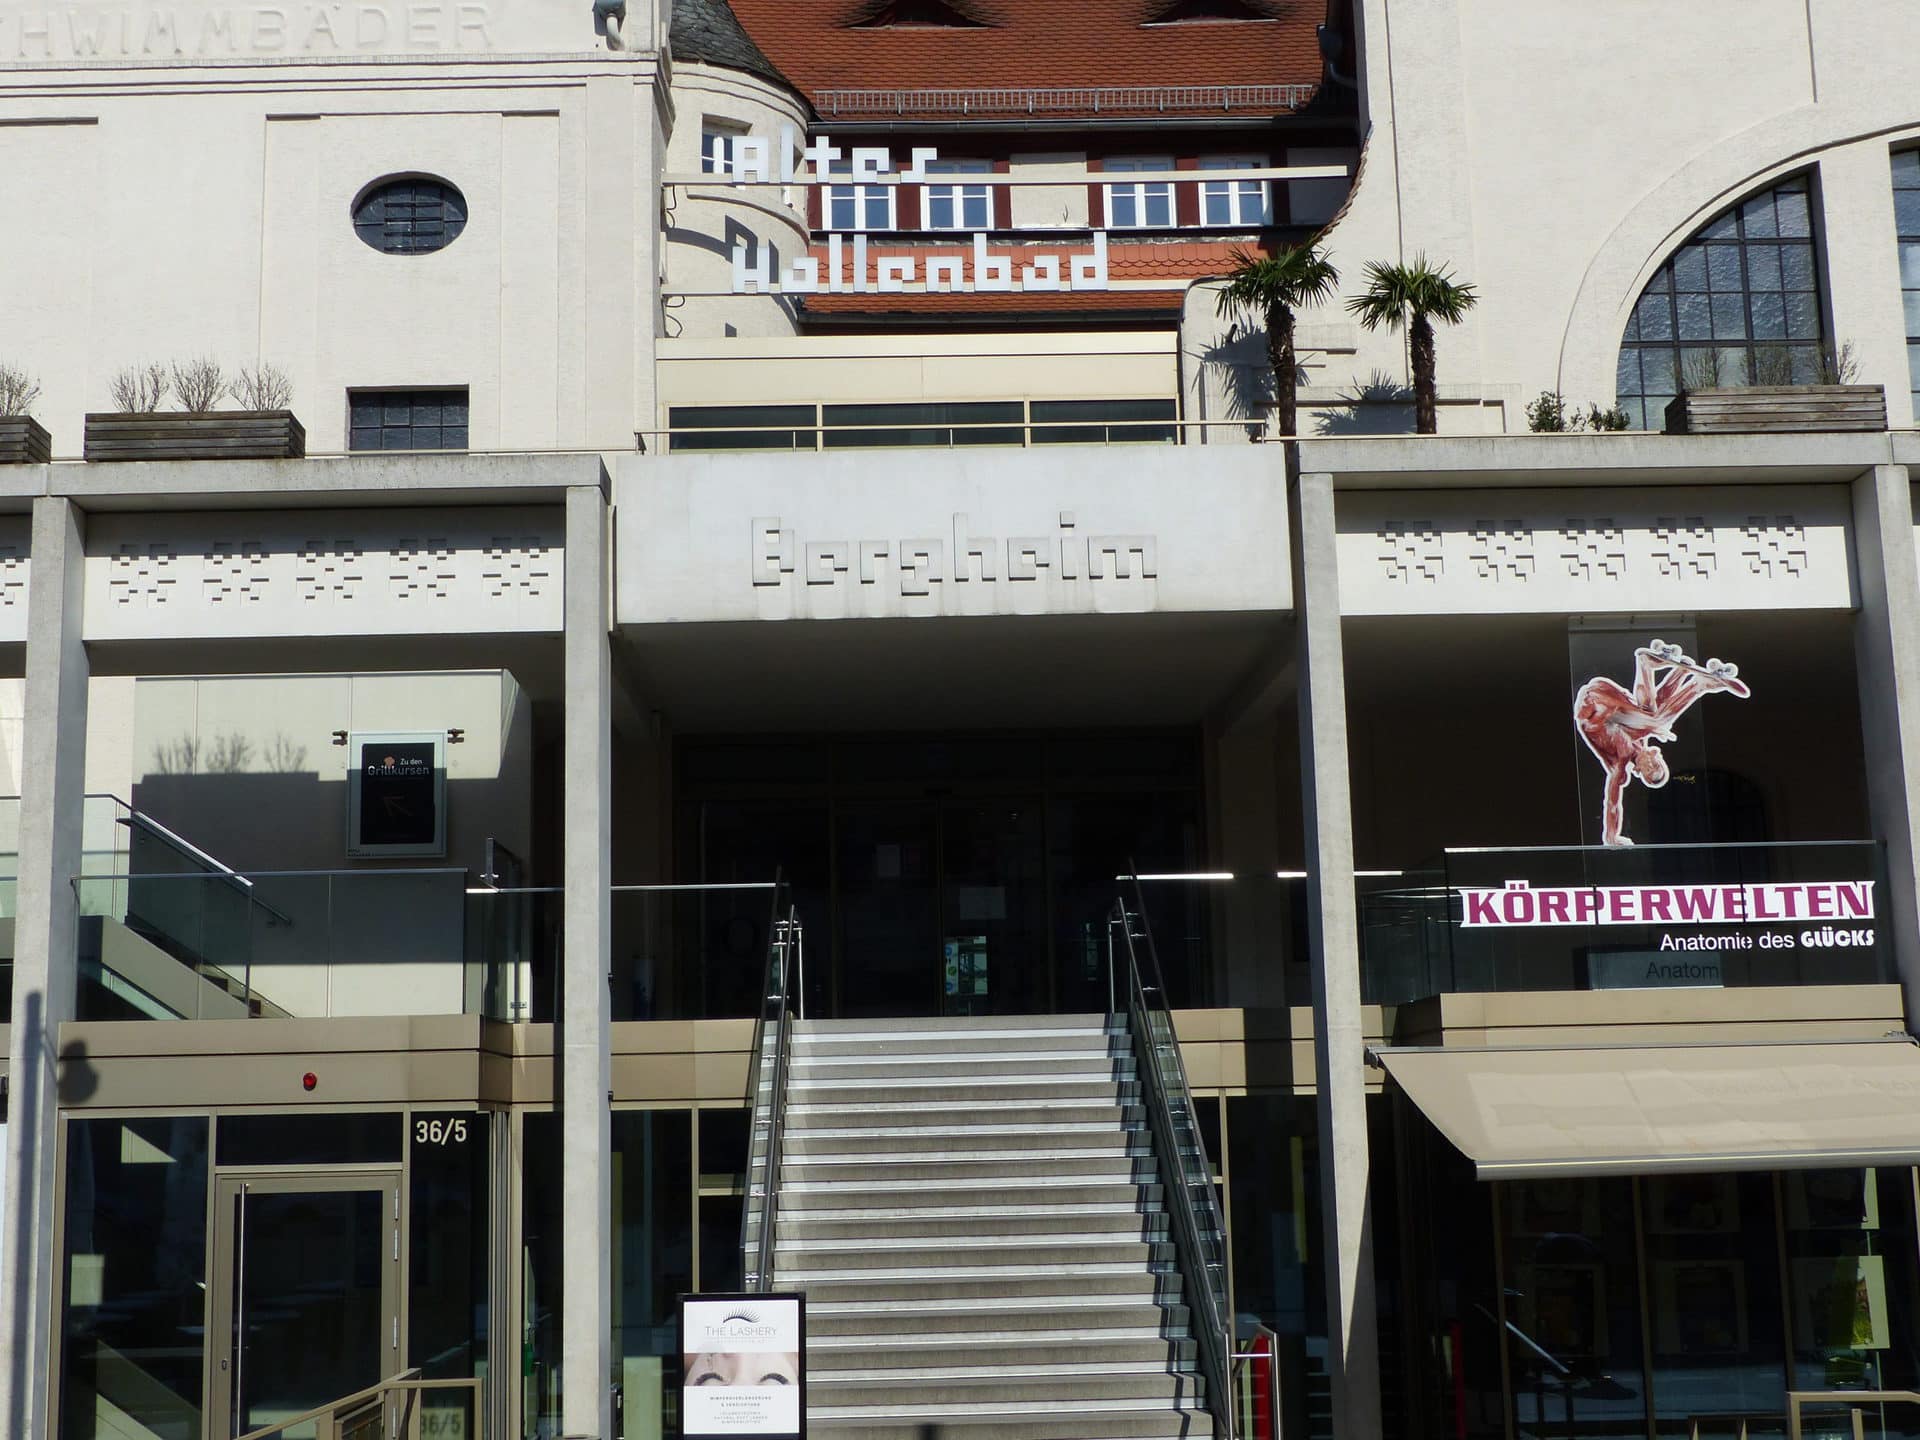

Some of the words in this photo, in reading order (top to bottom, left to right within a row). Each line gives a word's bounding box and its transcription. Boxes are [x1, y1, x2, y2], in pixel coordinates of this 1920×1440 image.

[0, 3, 493, 57] HWIMMBÄDER
[732, 123, 938, 184] Alter
[732, 232, 1108, 293] Hallenbad
[752, 512, 1158, 596] Bergheim
[400, 758, 409, 766] Zu
[1467, 882, 1870, 925] KÖRPERWELTEN
[1660, 932, 1752, 951] Anatomie
[1759, 931, 1795, 949] des
[1801, 926, 1875, 948] GLÜCKS
[415, 1117, 467, 1146] 36/5
[705, 1326, 726, 1336] THE
[730, 1326, 777, 1336] LASHERY
